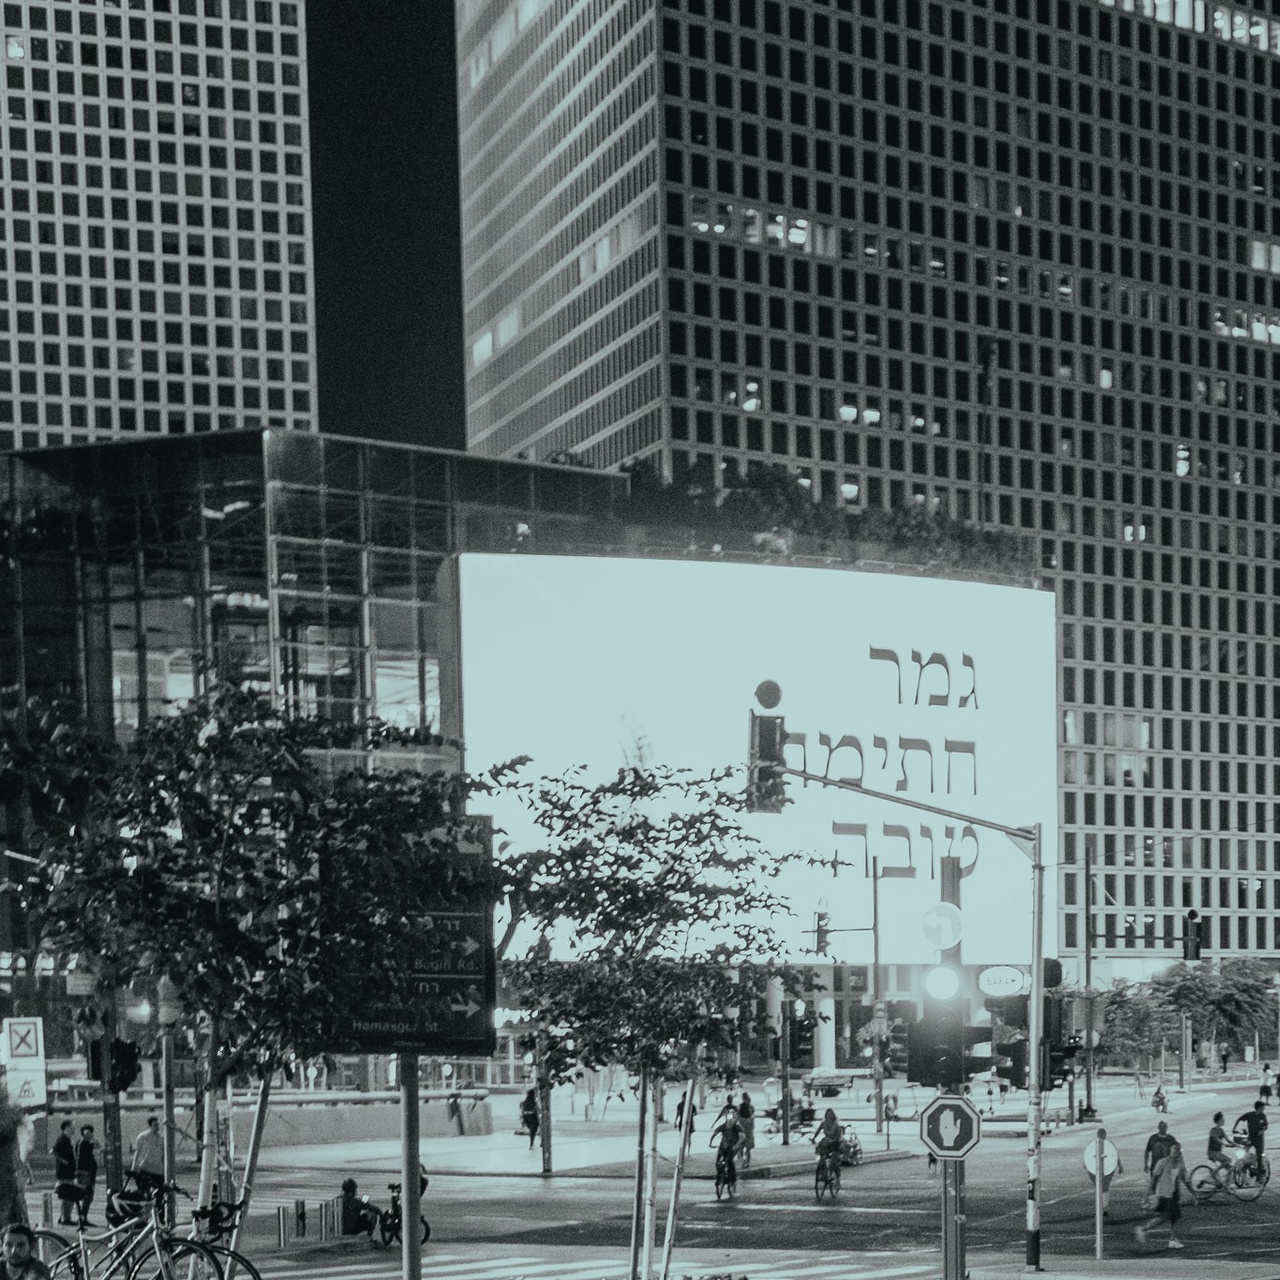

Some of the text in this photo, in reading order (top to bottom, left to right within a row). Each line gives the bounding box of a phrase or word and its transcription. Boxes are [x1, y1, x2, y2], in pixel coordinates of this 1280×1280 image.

[869, 643, 978, 710] גמר
[832, 819, 979, 880] טובה
[457, 958, 479, 971] Rd.
